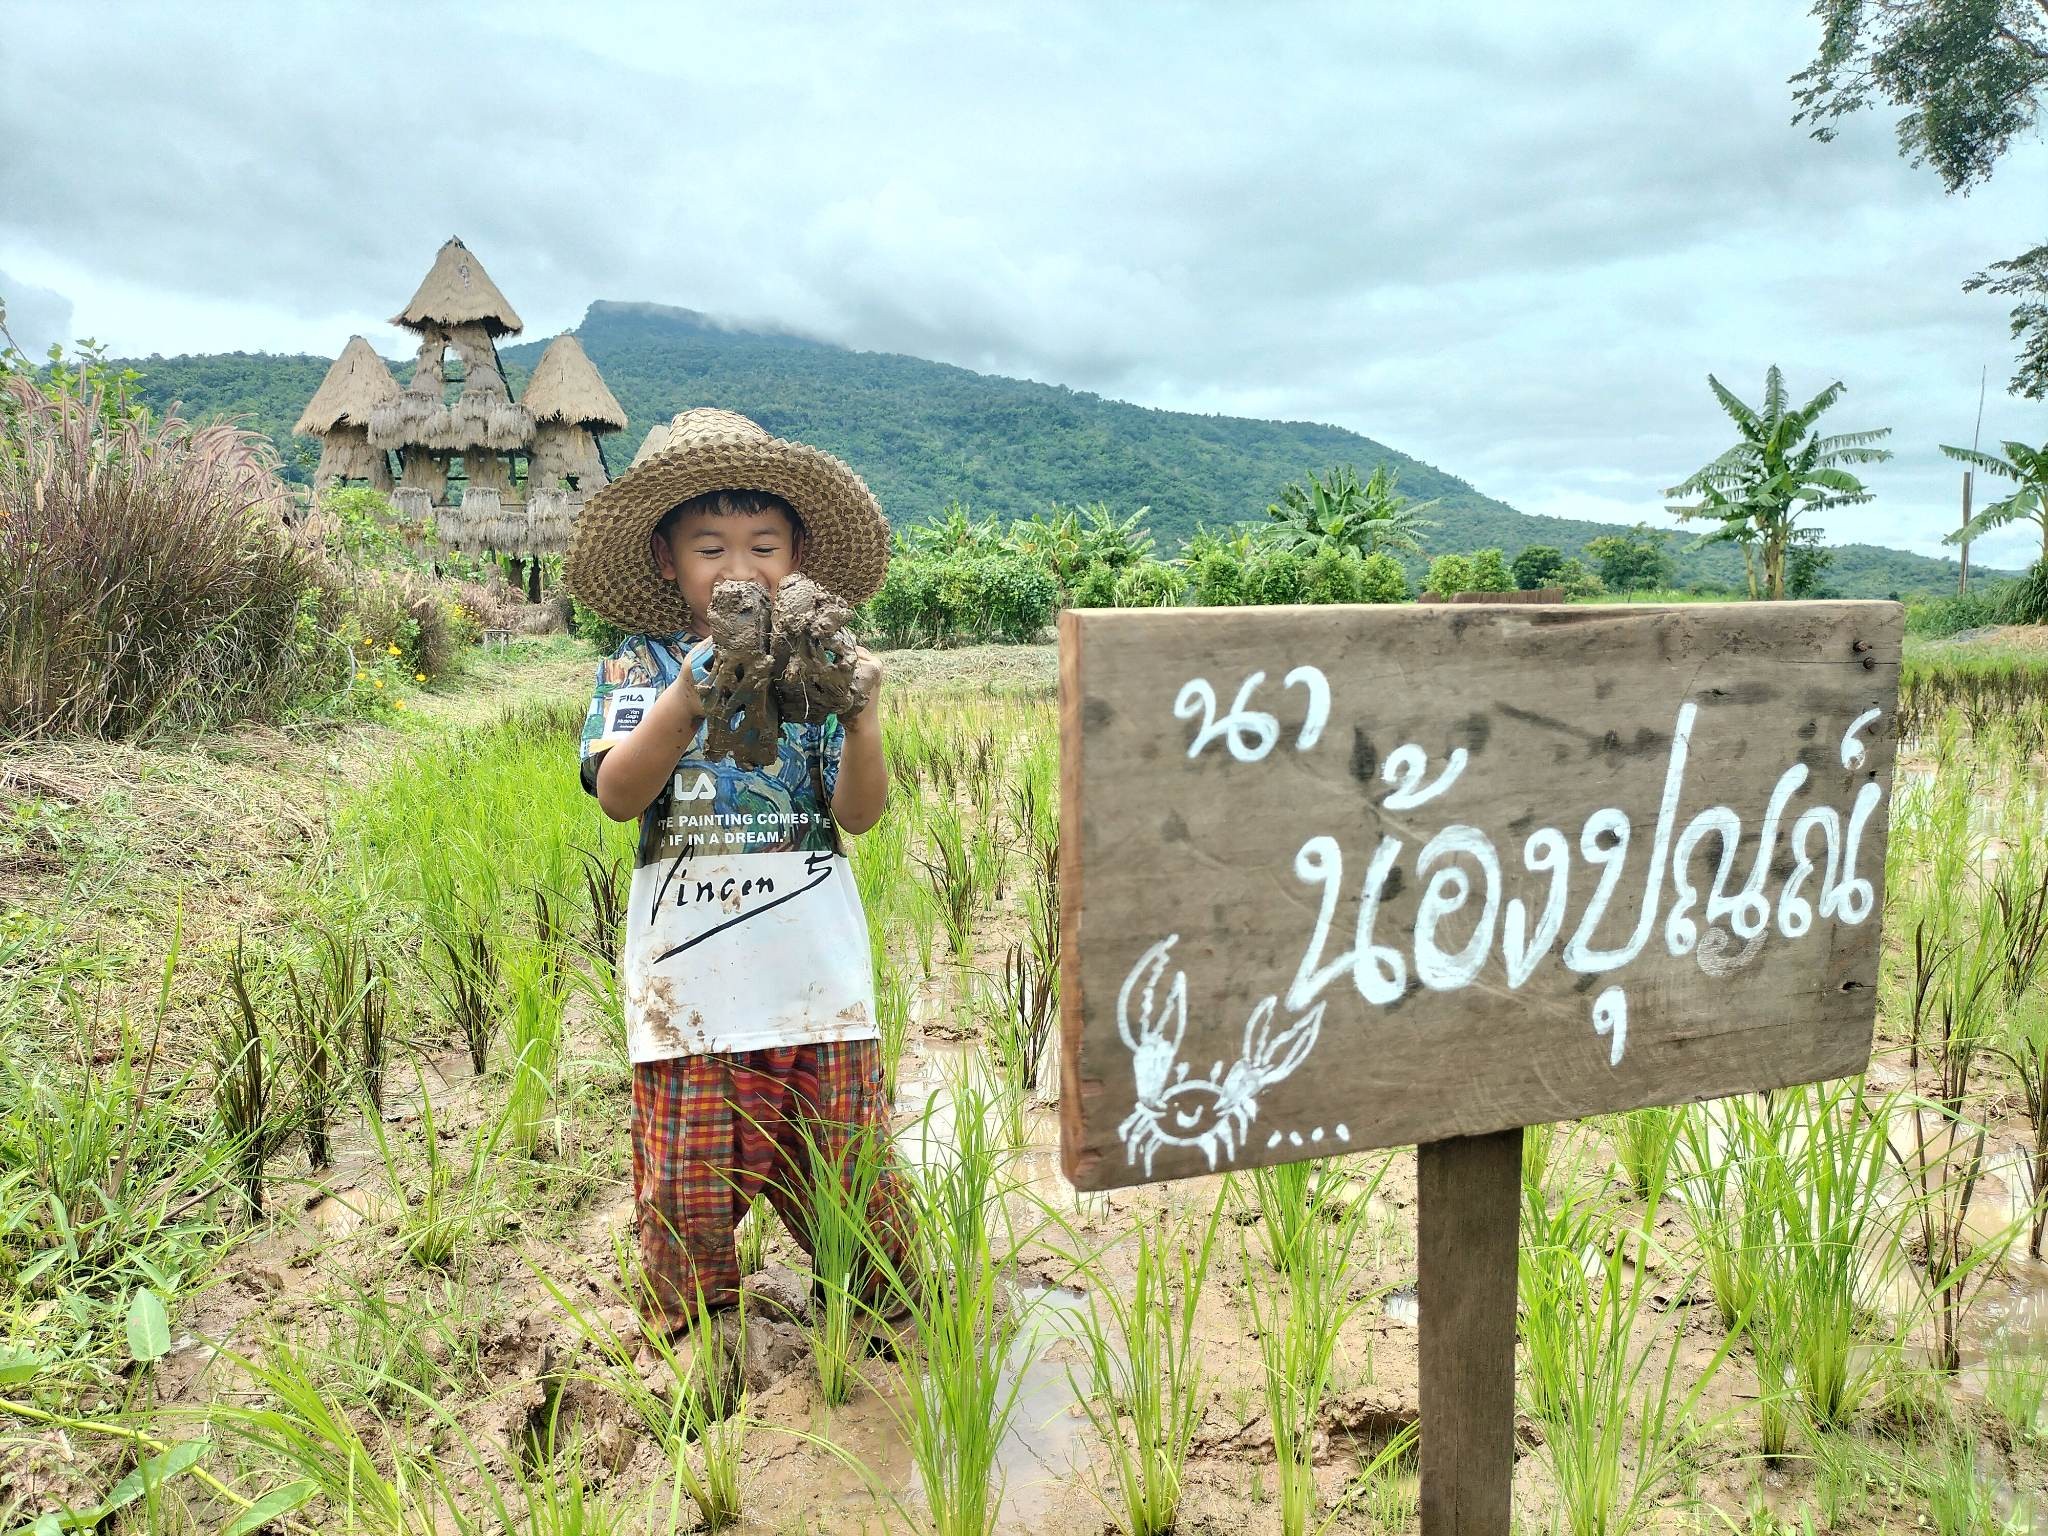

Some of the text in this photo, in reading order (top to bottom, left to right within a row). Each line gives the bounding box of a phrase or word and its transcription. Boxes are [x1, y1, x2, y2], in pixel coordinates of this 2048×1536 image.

[619, 694, 645, 703] FILA
[1174, 664, 1332, 762] นา
[674, 772, 717, 801] LA
[678, 813, 753, 827] PAINTING
[757, 813, 809, 825] COMES
[669, 834, 683, 847] IF
[688, 833, 704, 846] IN
[709, 832, 719, 844] A
